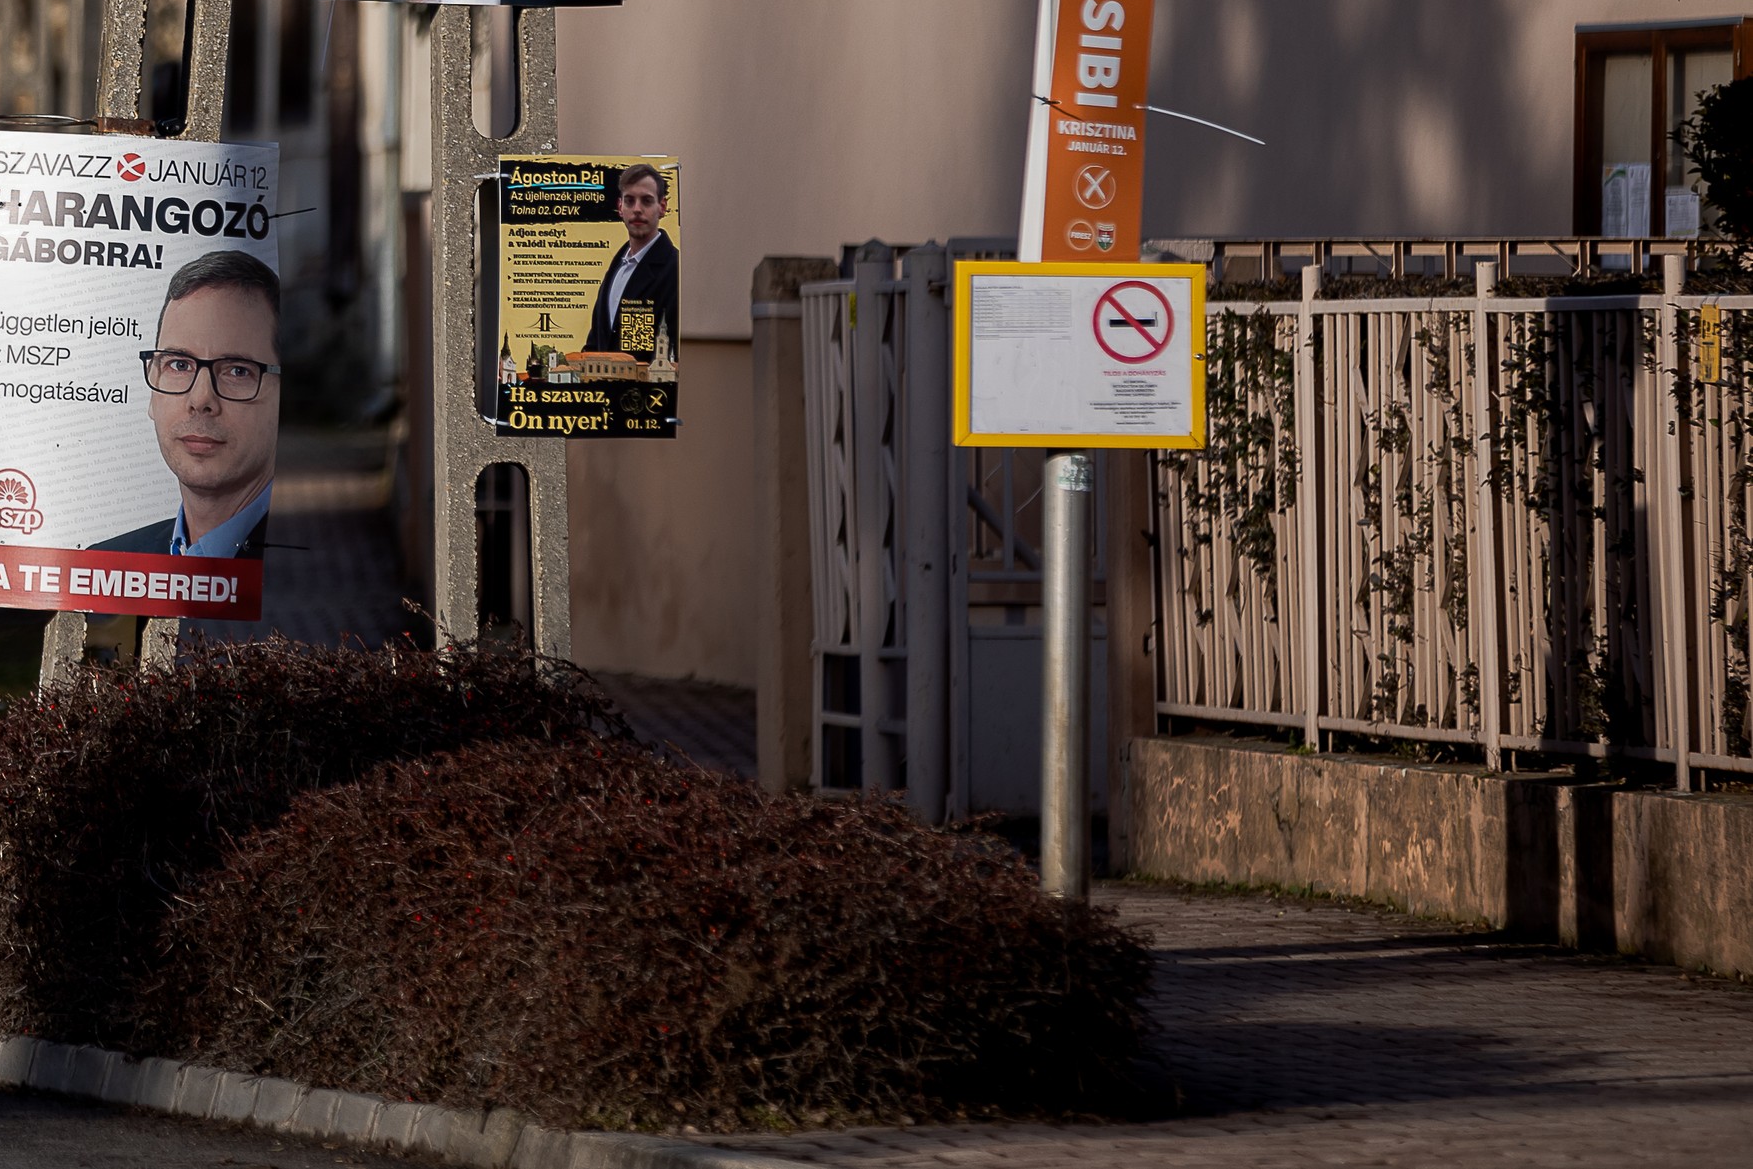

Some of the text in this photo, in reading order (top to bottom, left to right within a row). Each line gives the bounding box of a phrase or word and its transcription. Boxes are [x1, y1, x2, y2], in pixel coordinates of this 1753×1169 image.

[1058, 120, 1137, 140] KRISZTINA
[1068, 141, 1127, 155] JANUÁR 12.
[148, 158, 246, 187] JANUÁR
[250, 166, 269, 190] 12.
[511, 166, 604, 187] Ágoston Pál
[511, 191, 523, 201] Az
[525, 191, 572, 203] újellenzék
[511, 205, 580, 215] Tolna 02. OEVK
[508, 228, 566, 238] Adjon esélyt
[516, 240, 546, 248] valódi
[548, 240, 609, 249] változásnak!
[88, 316, 143, 340] jelölt,
[6, 344, 71, 366] MSZP
[509, 387, 611, 406] Ha szavaz,
[509, 405, 609, 435] Ön nyer!
[626, 418, 661, 429] 01. 12.
[19, 564, 60, 593] TE
[69, 568, 238, 603] EMBERED!
